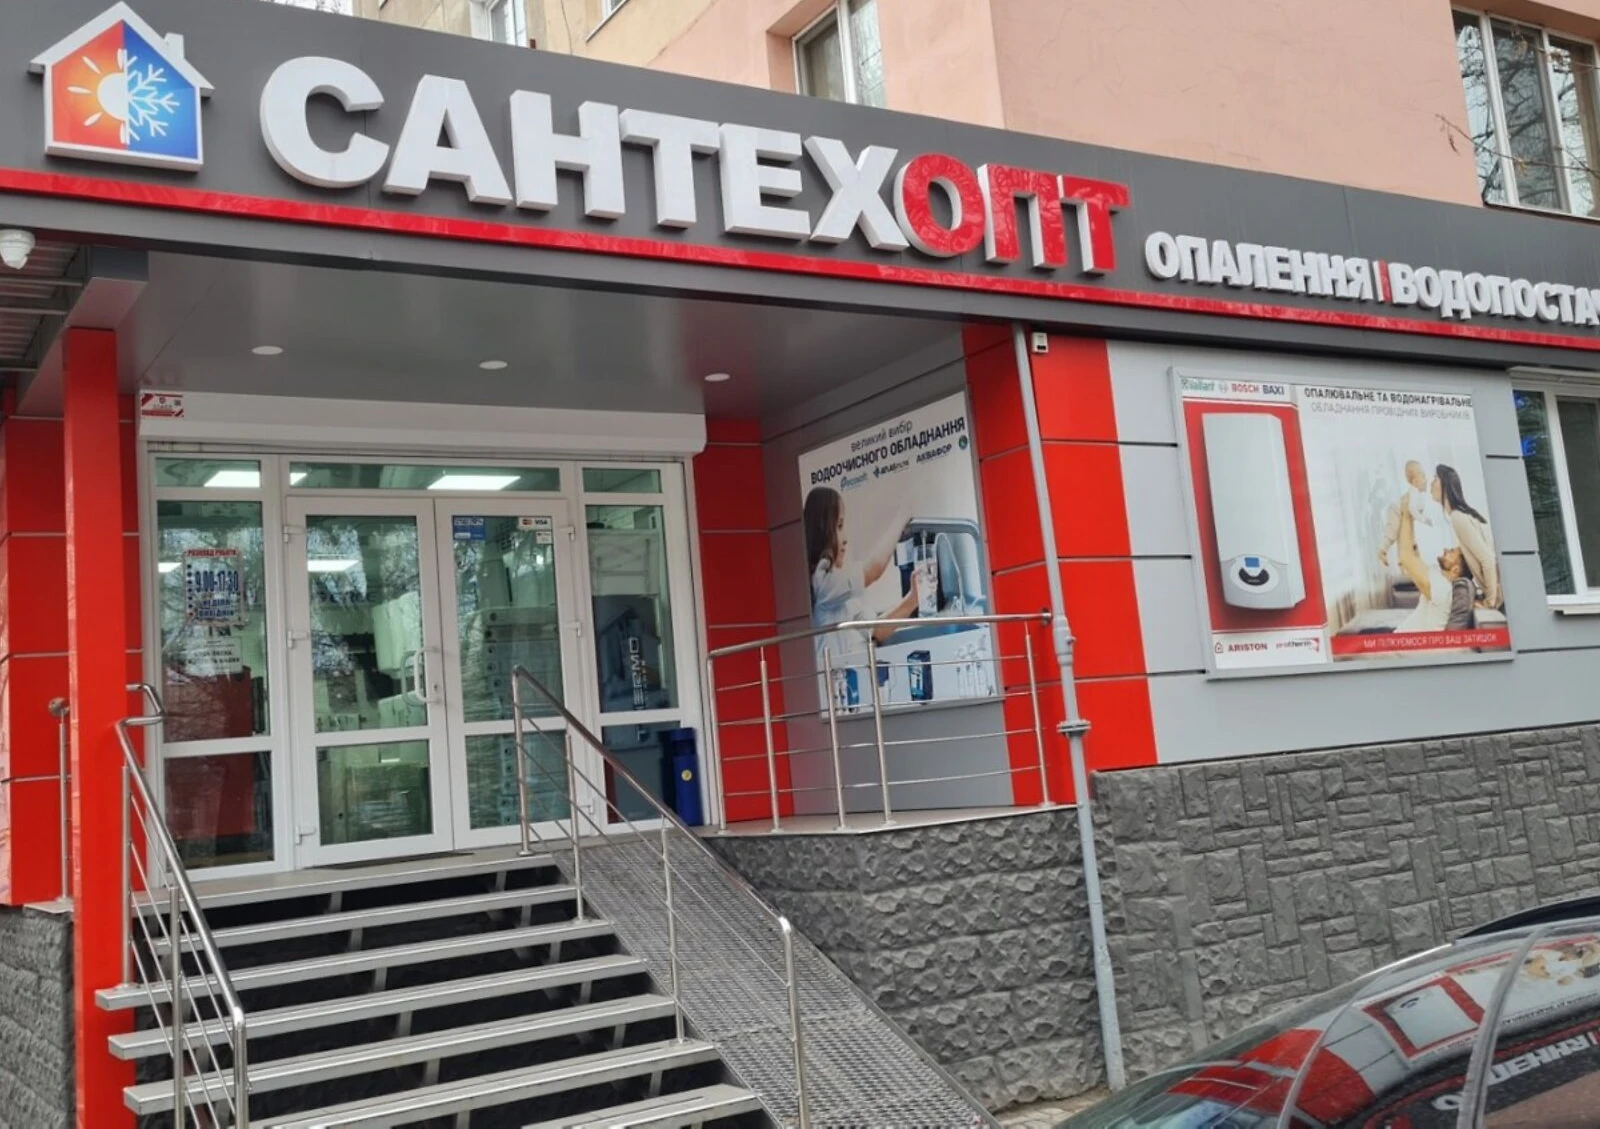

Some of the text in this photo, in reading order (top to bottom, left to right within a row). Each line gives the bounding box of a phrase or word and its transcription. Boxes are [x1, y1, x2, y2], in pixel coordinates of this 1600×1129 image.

[260, 56, 1129, 273] САНТЕХОПТ
[1145, 231, 1374, 300] ОПАЛЕННЯ
[1232, 384, 1259, 393] BOSCH
[1263, 385, 1284, 395] BAXI
[1304, 388, 1472, 407] ОПАЛЮВАЛЬНЕ ТА ВОДОНАГРІВАЛЬНЕ
[851, 420, 913, 452] великий вибір
[811, 417, 965, 485] ВОДООЧИСНОГО ОБЛАДНАННЯ
[916, 444, 952, 463] АКВАФОР
[1228, 643, 1268, 652] ARISTON
[1364, 638, 1375, 648] МИ
[1428, 634, 1444, 645] ПРО
[1446, 634, 1461, 644] ВАШ
